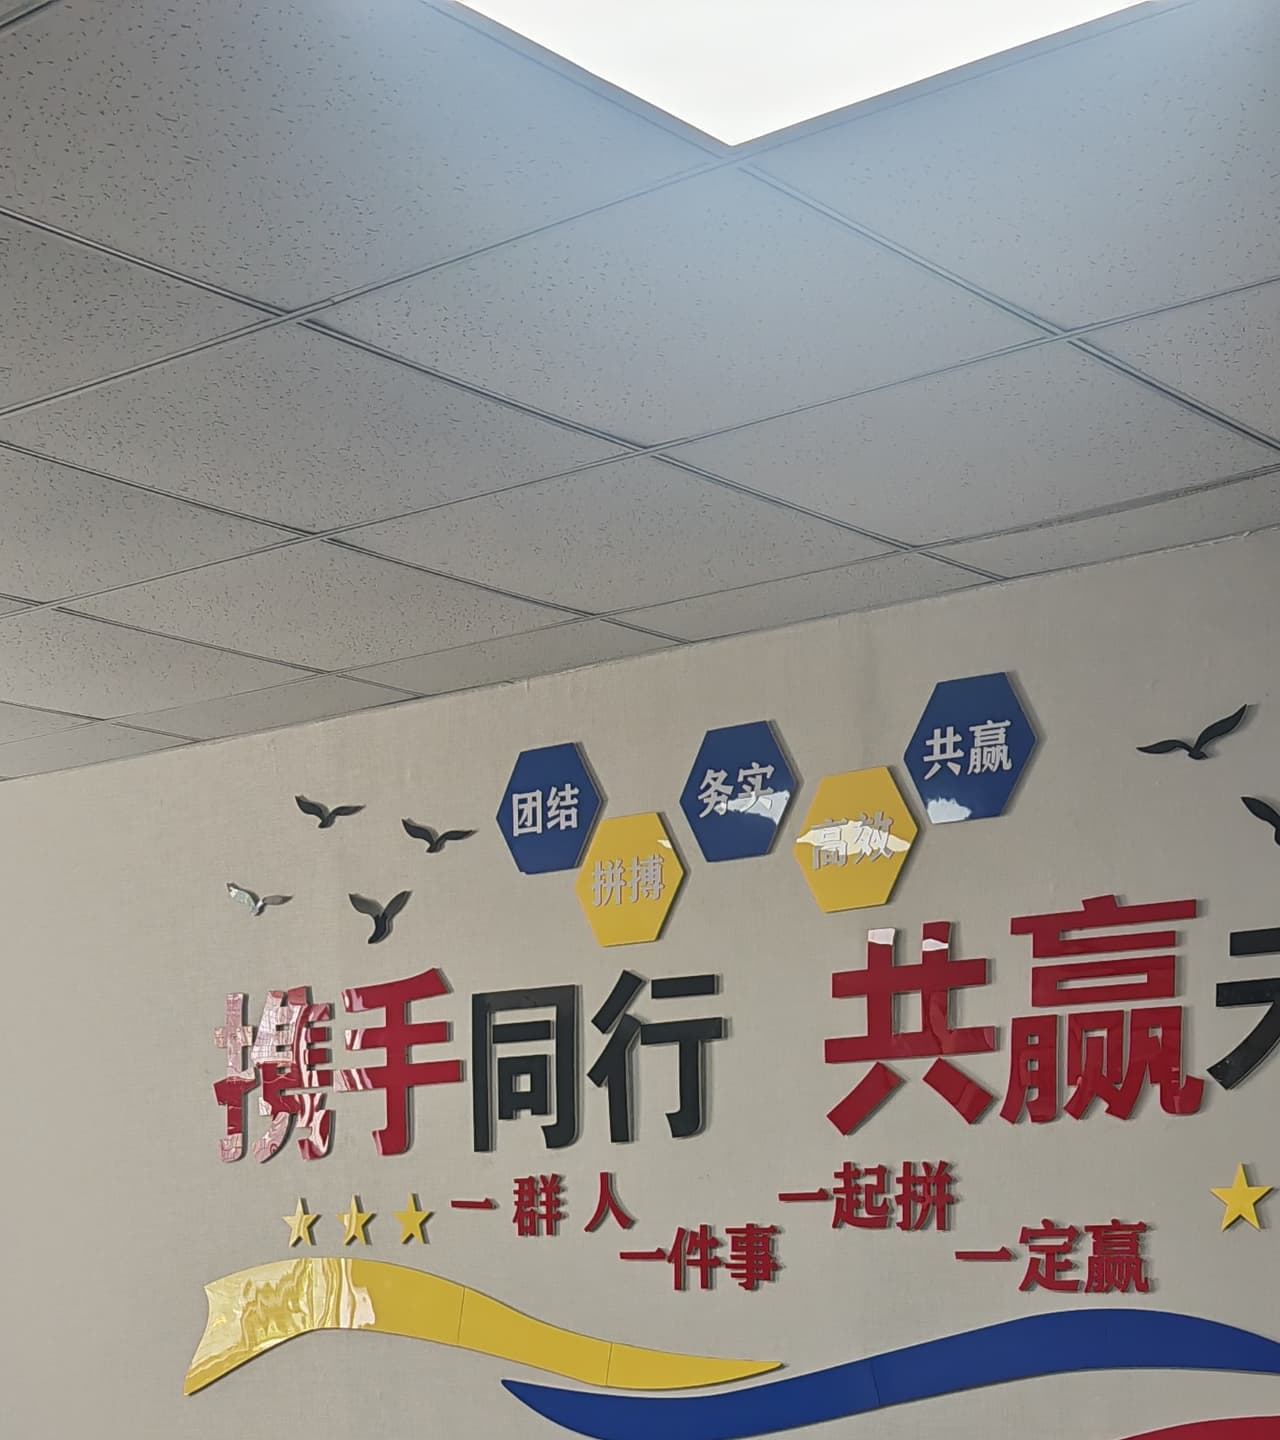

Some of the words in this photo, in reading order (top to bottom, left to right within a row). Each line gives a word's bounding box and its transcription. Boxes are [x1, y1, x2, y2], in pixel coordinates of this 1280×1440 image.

[923, 719, 1013, 777] 共赢
[511, 782, 580, 837] 团结
[697, 761, 775, 818] 务实
[810, 810, 894, 871] 高效
[591, 853, 666, 907] 拼搏
[214, 967, 728, 1164] 携手同行
[451, 1172, 634, 1238] 一群人
[778, 1160, 960, 1233] 一起拼
[619, 1223, 782, 1292] 一件事
[955, 1219, 1151, 1295] 一定赢
